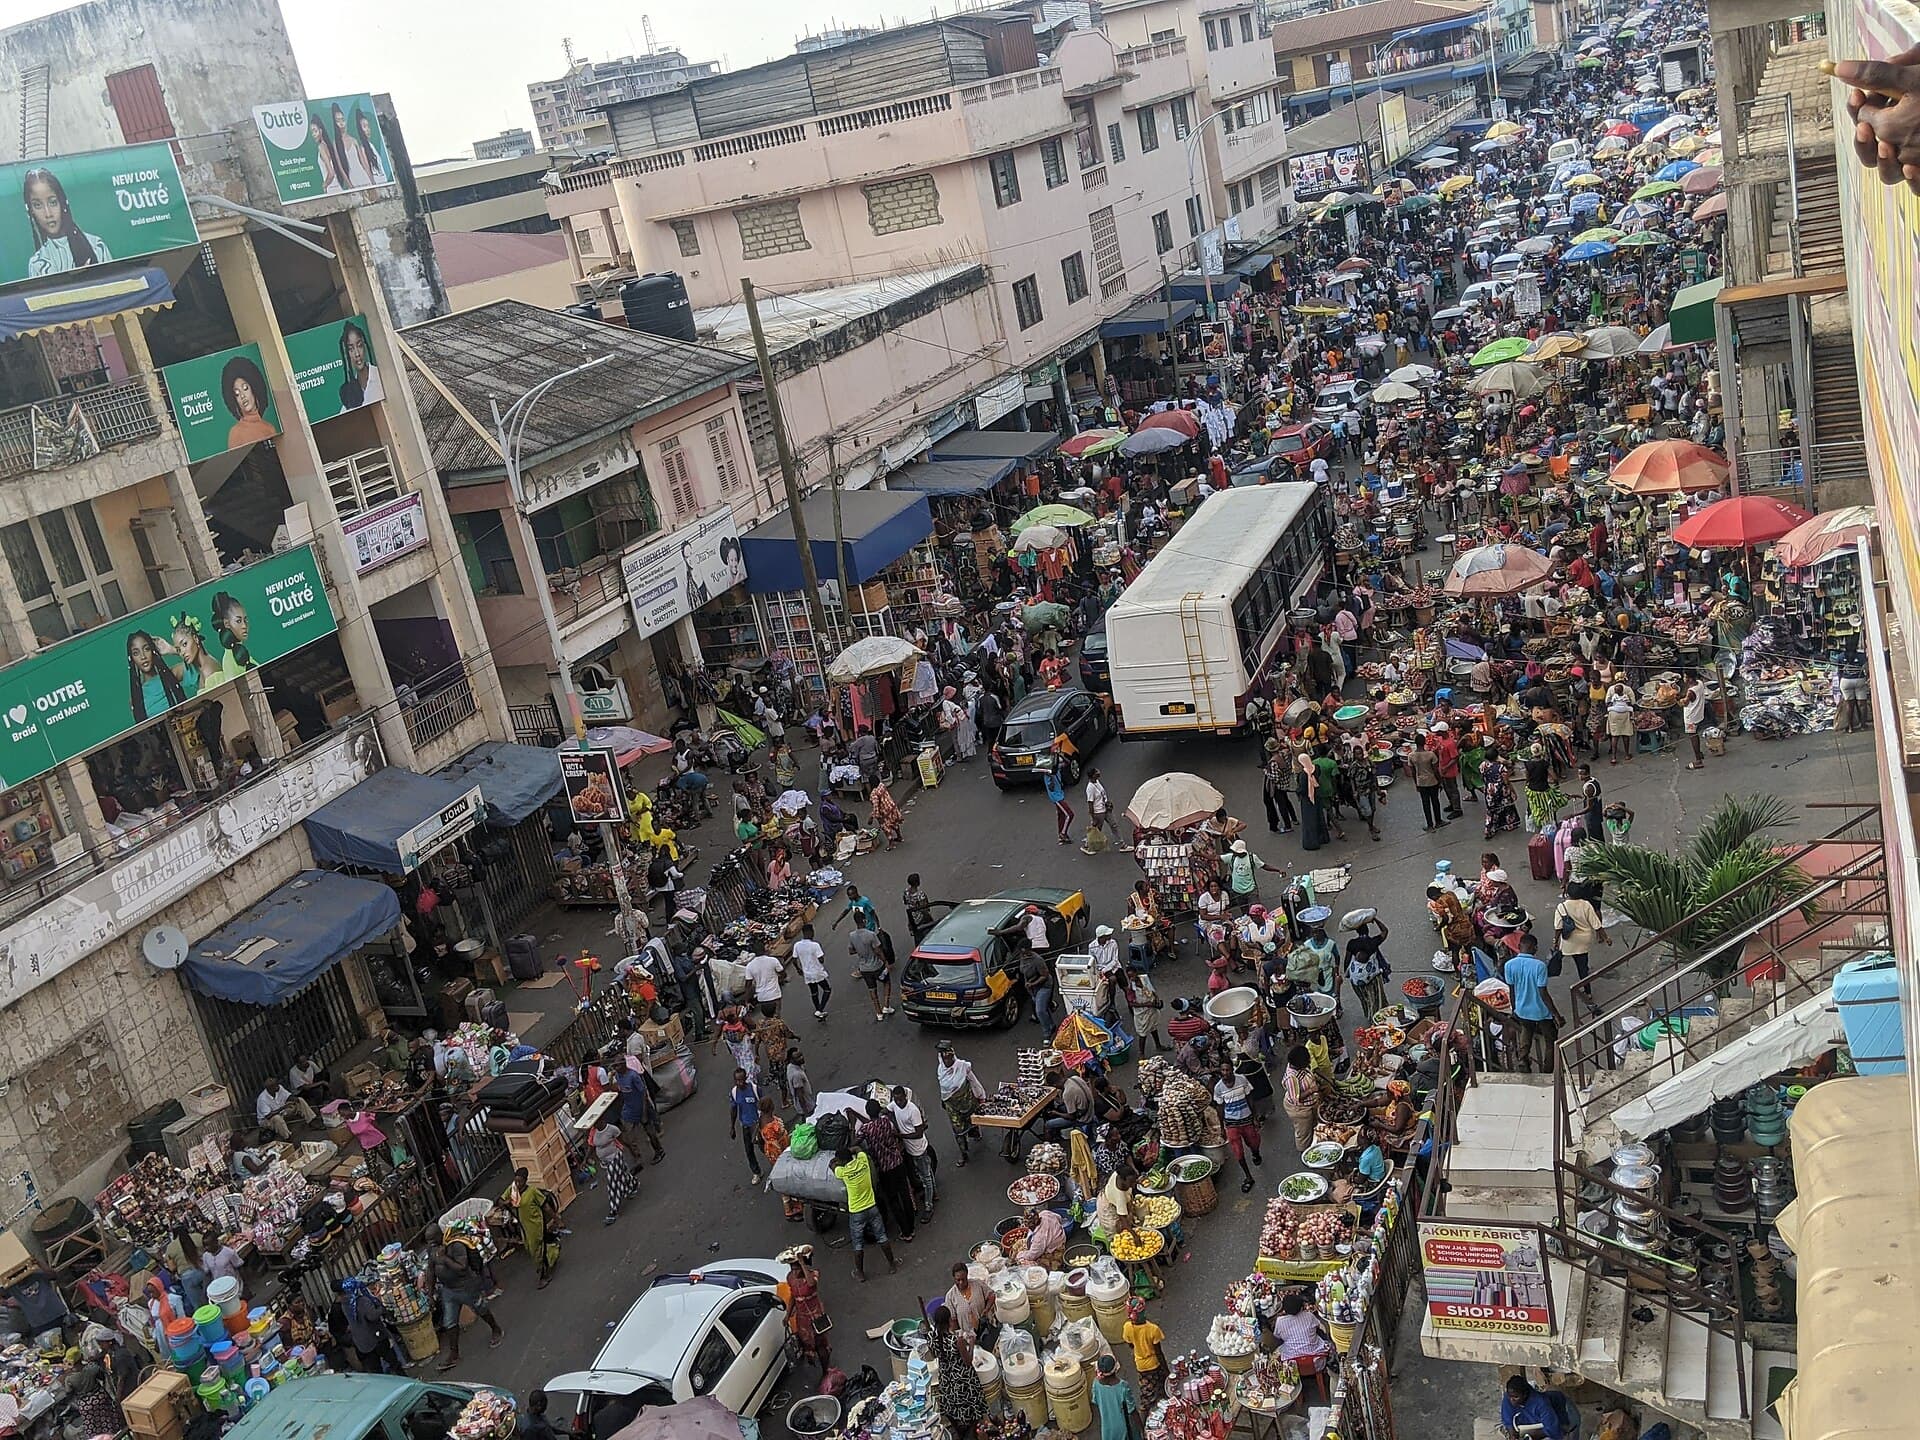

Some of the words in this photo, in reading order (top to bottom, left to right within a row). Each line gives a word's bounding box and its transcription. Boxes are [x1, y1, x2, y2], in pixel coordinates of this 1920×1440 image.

[261, 106, 303, 129] Outré
[112, 173, 134, 187] NEW
[134, 169, 160, 182] LOOK
[115, 182, 169, 211] Outré
[306, 363, 333, 377] COMPANY
[332, 359, 343, 369] LTD
[181, 393, 194, 404] NEW
[193, 390, 208, 400] LOOK
[183, 399, 213, 418] Outré
[265, 581, 284, 596] NEW
[284, 571, 305, 588] LOOK
[269, 583, 314, 617] Outré
[2, 714, 11, 729] I
[36, 679, 86, 711] OUTRE
[12, 723, 37, 742] Braid
[46, 711, 64, 725] and
[63, 699, 90, 718] More!
[444, 801, 466, 822] JOHN
[111, 852, 154, 894] GIFT
[155, 826, 200, 866] HAIR
[119, 848, 203, 907] KOLLECTION
[1422, 1226, 1471, 1239] AKONIT
[1473, 1229, 1530, 1242] FABRICS
[1450, 1256, 1467, 1264] TYPES
[1464, 1251, 1500, 1259] UNIFORMS
[1447, 1305, 1494, 1318] SHOP
[1498, 1308, 1529, 1321] 140
[1436, 1317, 1462, 1328] TEL:
[1465, 1320, 1544, 1334] 0249703900
